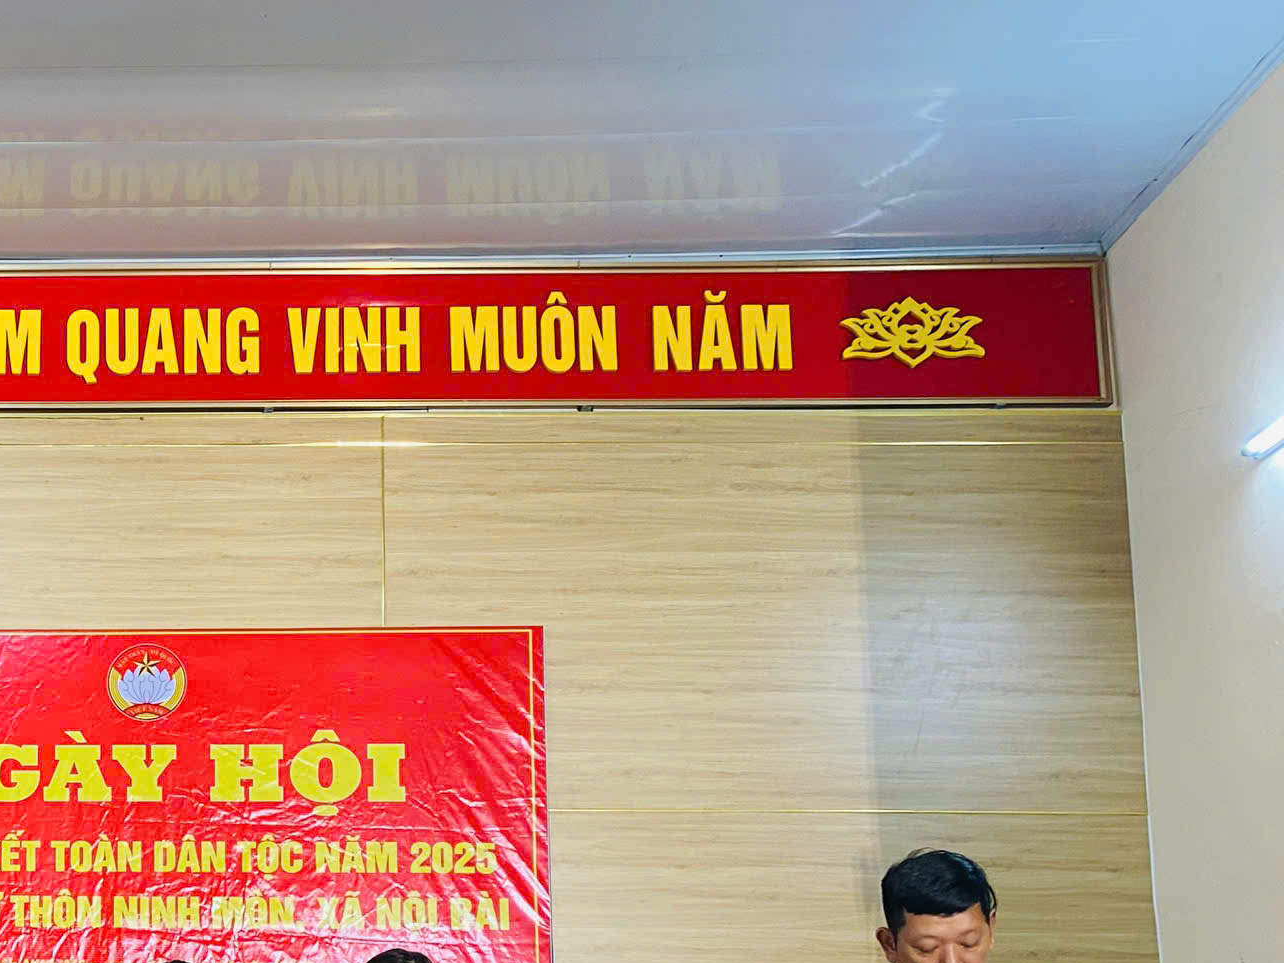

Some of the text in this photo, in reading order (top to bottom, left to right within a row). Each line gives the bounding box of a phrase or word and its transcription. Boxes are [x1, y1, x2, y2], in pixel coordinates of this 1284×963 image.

[67, 307, 260, 383] QUANG
[288, 306, 421, 373] VINH
[450, 291, 618, 372] MUÔN
[653, 290, 793, 371] NĂM
[210, 729, 406, 815] HỘI
[51, 834, 142, 873] TOÀN
[154, 834, 226, 873] DÂN
[241, 835, 303, 880] TỘC
[313, 835, 398, 874] NĂM
[410, 841, 499, 874] 2025
[10, 889, 103, 928] THÔN
[114, 895, 200, 928] NINH
[316, 890, 367, 929] XÃ
[450, 890, 510, 931] BÀI
